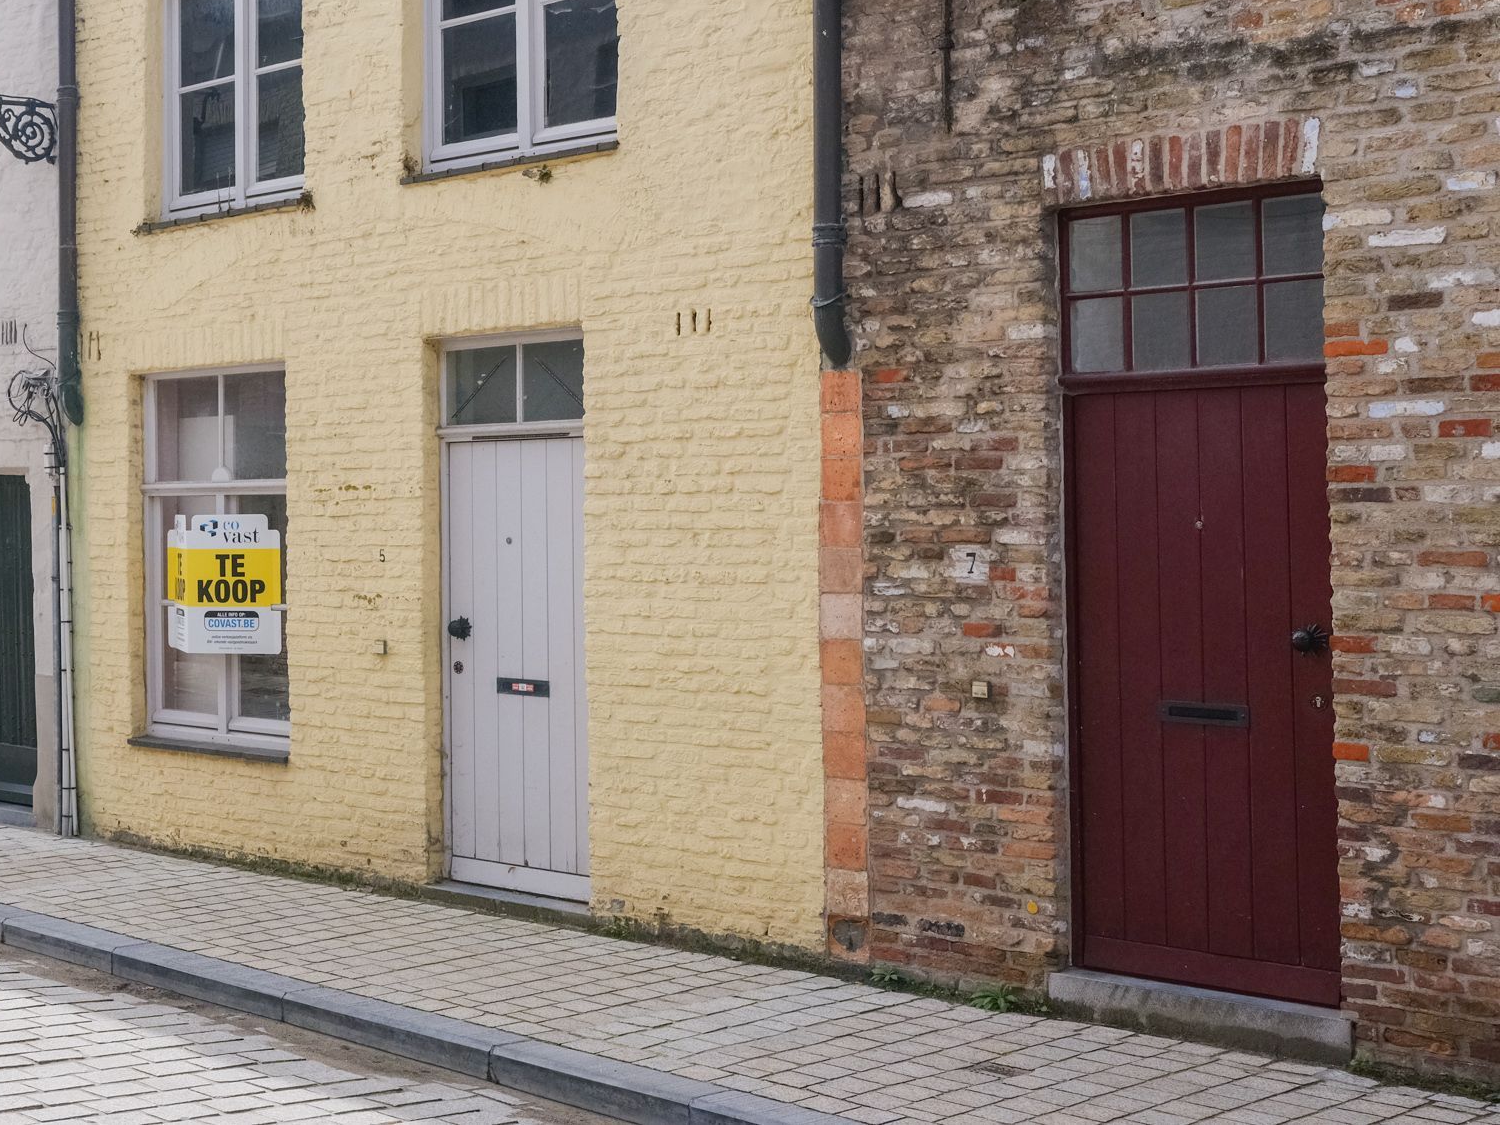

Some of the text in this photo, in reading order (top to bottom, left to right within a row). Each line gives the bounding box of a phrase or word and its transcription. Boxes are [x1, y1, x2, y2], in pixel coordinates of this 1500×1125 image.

[223, 528, 260, 543] vast
[379, 548, 386, 563] 5
[966, 552, 976, 574] 7
[215, 554, 245, 577] TE
[197, 579, 265, 602] KOOP
[208, 618, 255, 628] COVAST.BE
